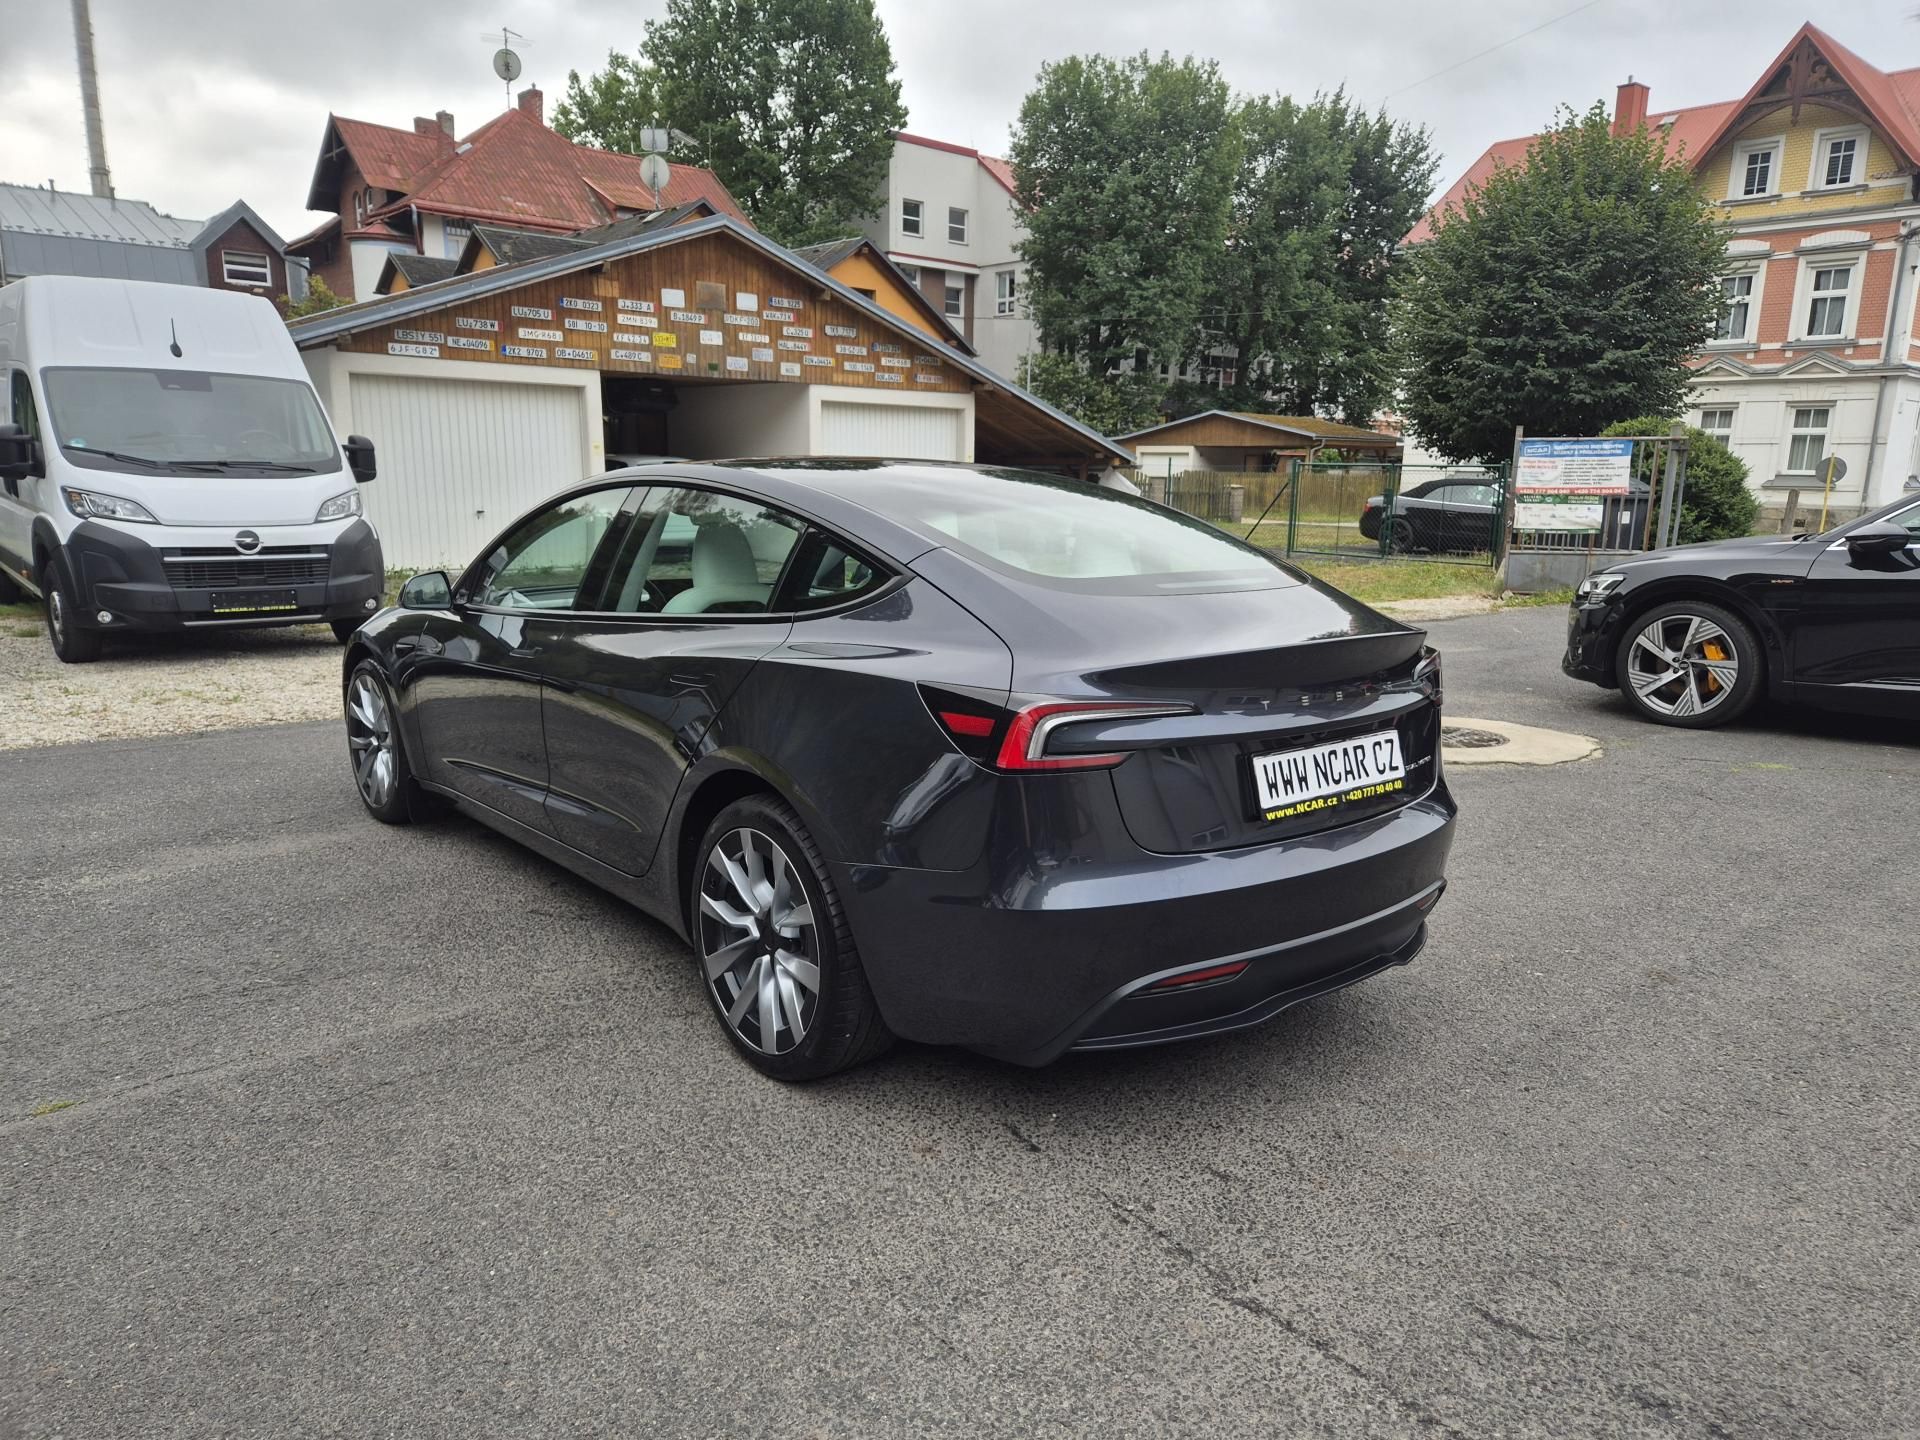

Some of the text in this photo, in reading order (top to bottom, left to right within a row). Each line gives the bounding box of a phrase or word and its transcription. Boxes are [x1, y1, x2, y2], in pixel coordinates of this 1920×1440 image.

[1262, 738, 1400, 800] WWW NCAR CZ
[1266, 797, 1338, 821] www.NCAR.cz
[1363, 785, 1376, 798] 777
[1376, 784, 1385, 795] 90
[1385, 782, 1394, 792] 40
[1394, 780, 1403, 790] 40
